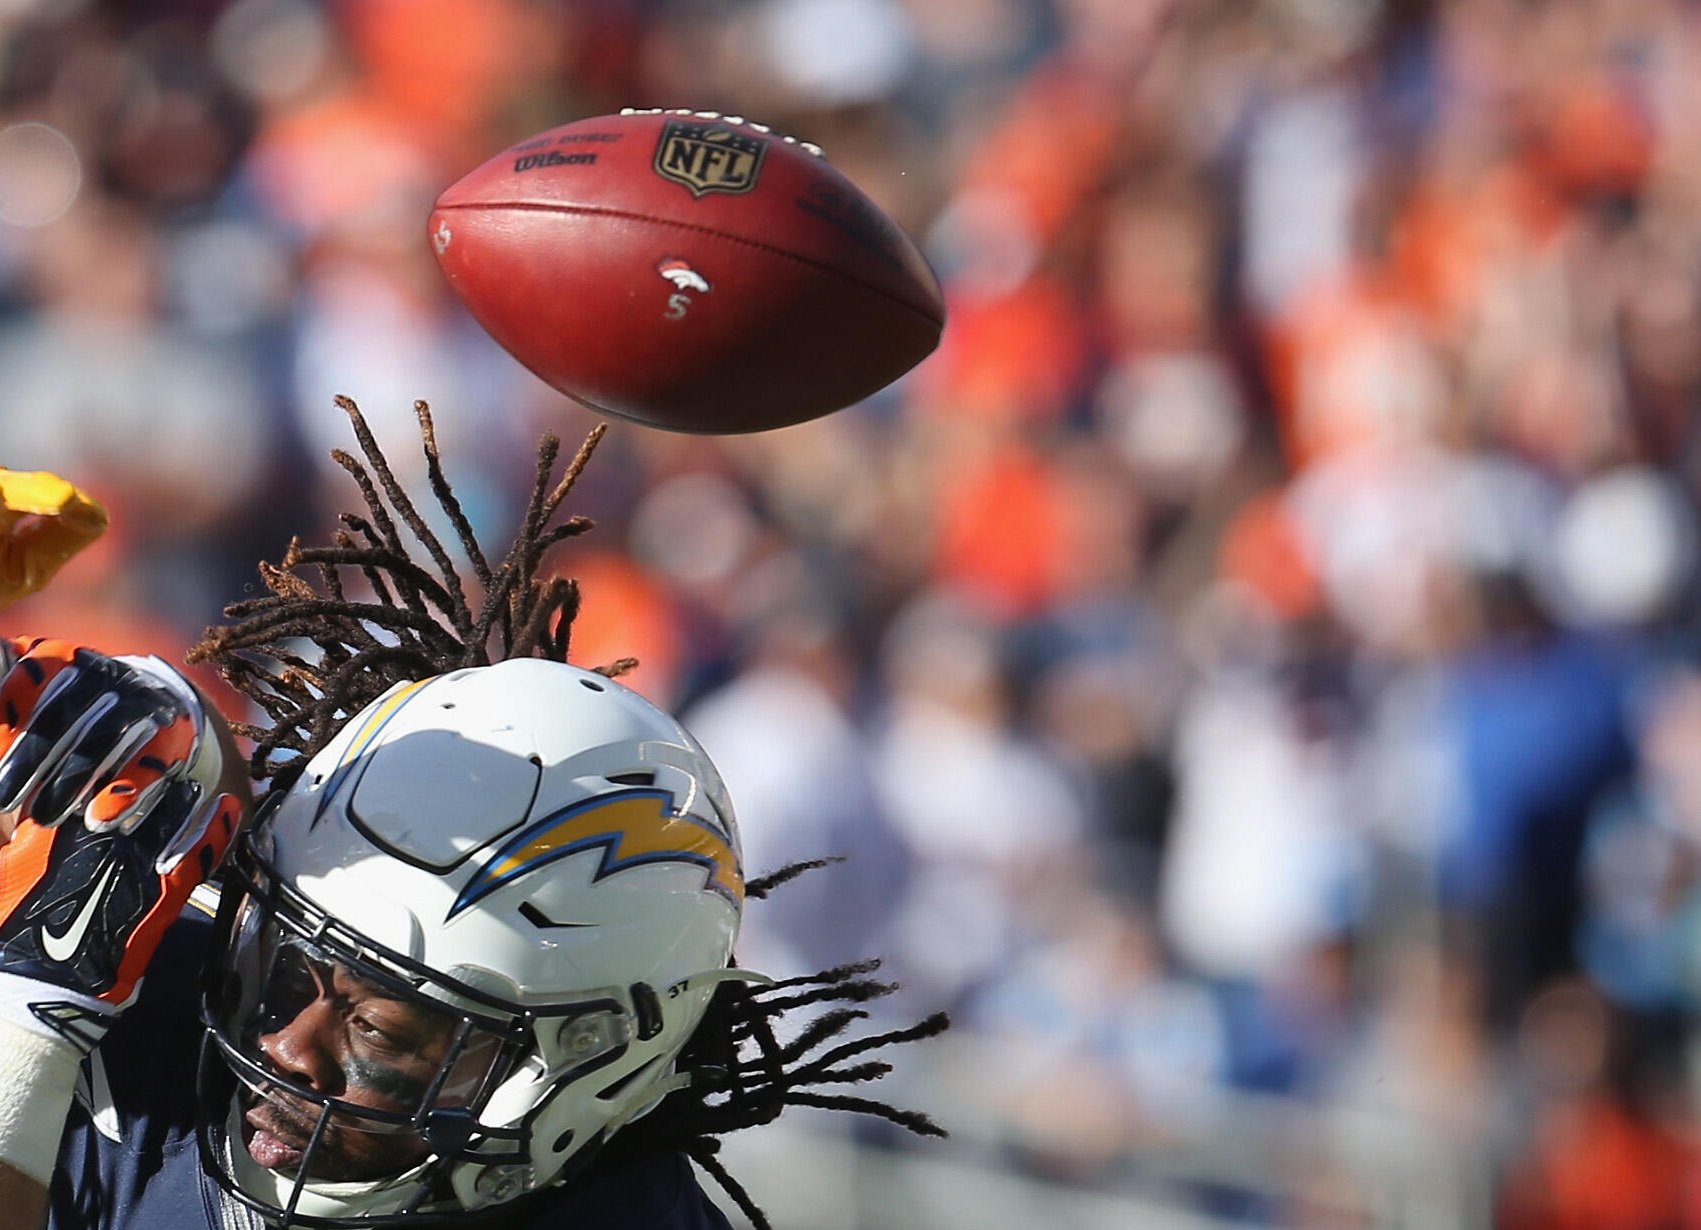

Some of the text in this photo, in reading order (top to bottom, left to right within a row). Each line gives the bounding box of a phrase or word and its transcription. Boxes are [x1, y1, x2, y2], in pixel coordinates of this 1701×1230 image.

[514, 151, 597, 172] Wilson
[667, 139, 748, 182] NFL
[668, 979, 689, 999] 37
